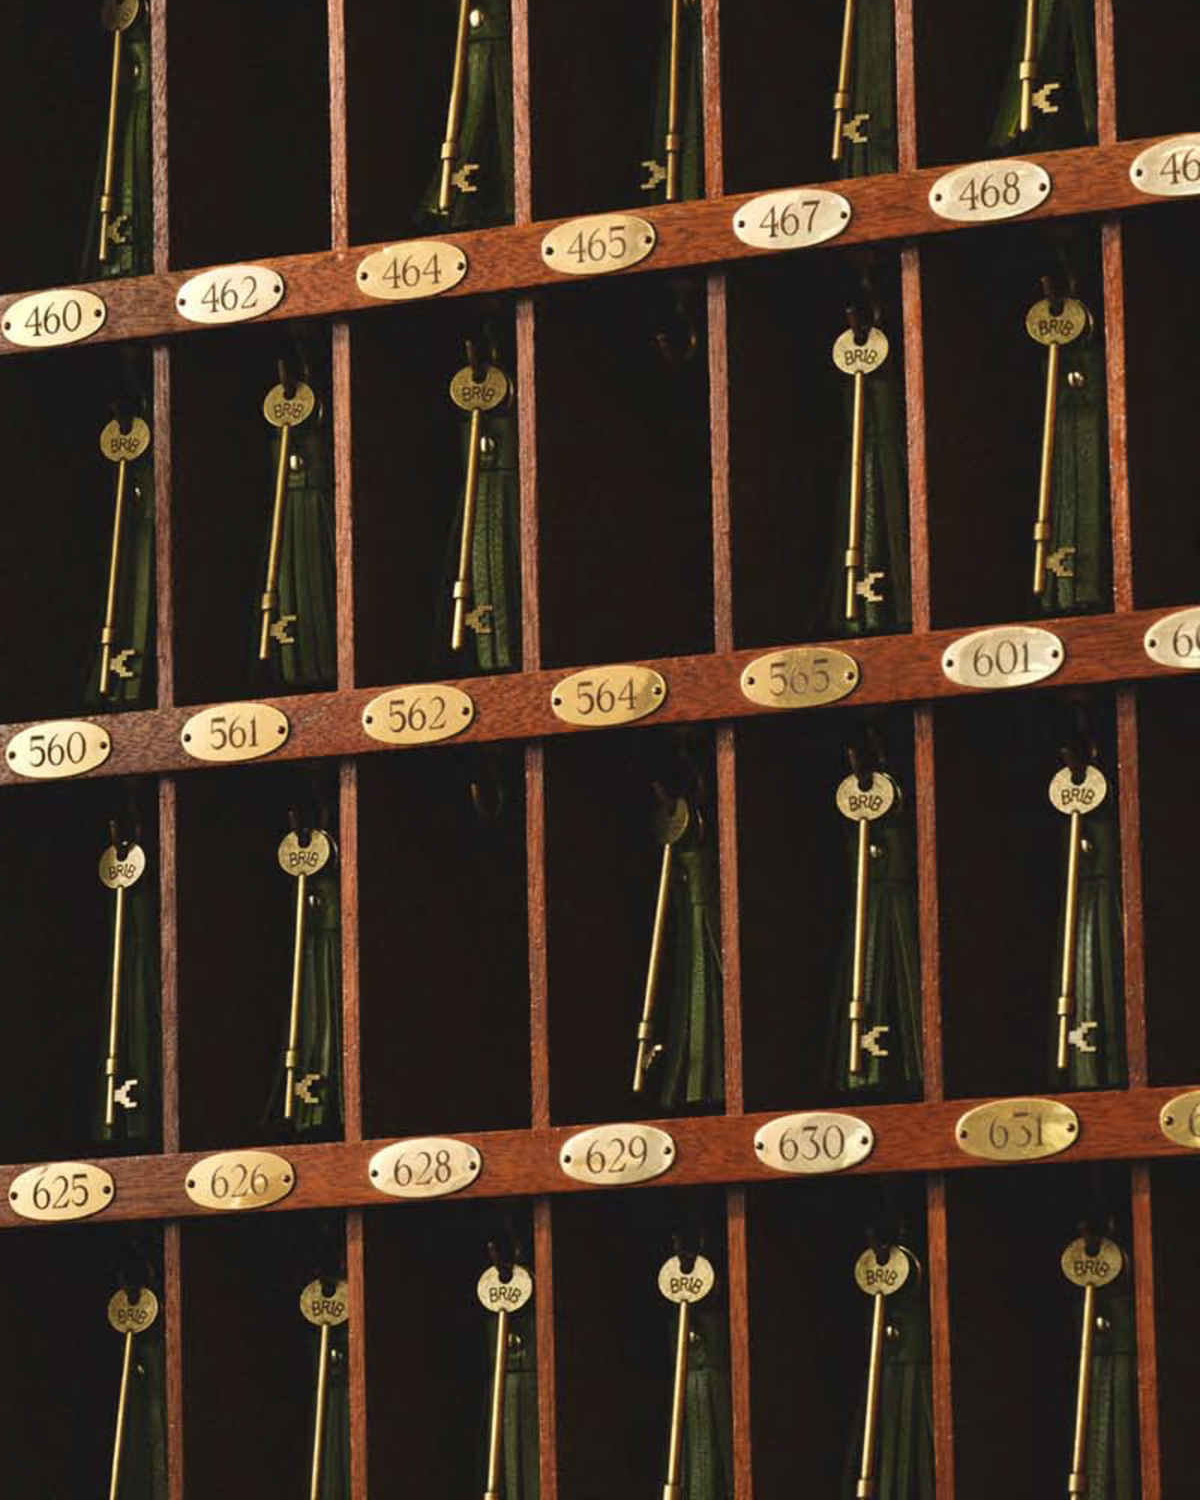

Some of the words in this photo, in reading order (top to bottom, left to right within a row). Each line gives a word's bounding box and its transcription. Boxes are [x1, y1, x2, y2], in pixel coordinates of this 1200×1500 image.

[959, 172, 1020, 210] 468
[760, 201, 820, 238] 467
[567, 226, 626, 263] 465
[382, 253, 441, 288] 464
[201, 276, 257, 312] 462
[25, 300, 82, 336] 460
[973, 640, 1032, 678] 601
[769, 659, 830, 696] 565
[576, 677, 636, 715] 564
[210, 715, 259, 750] 561
[389, 697, 446, 732] 562
[29, 732, 86, 767] 560
[586, 1136, 647, 1173] 629
[779, 1125, 845, 1161] 630
[211, 1164, 268, 1198] 626
[394, 1150, 451, 1186] 628
[33, 1174, 89, 1209] 625
